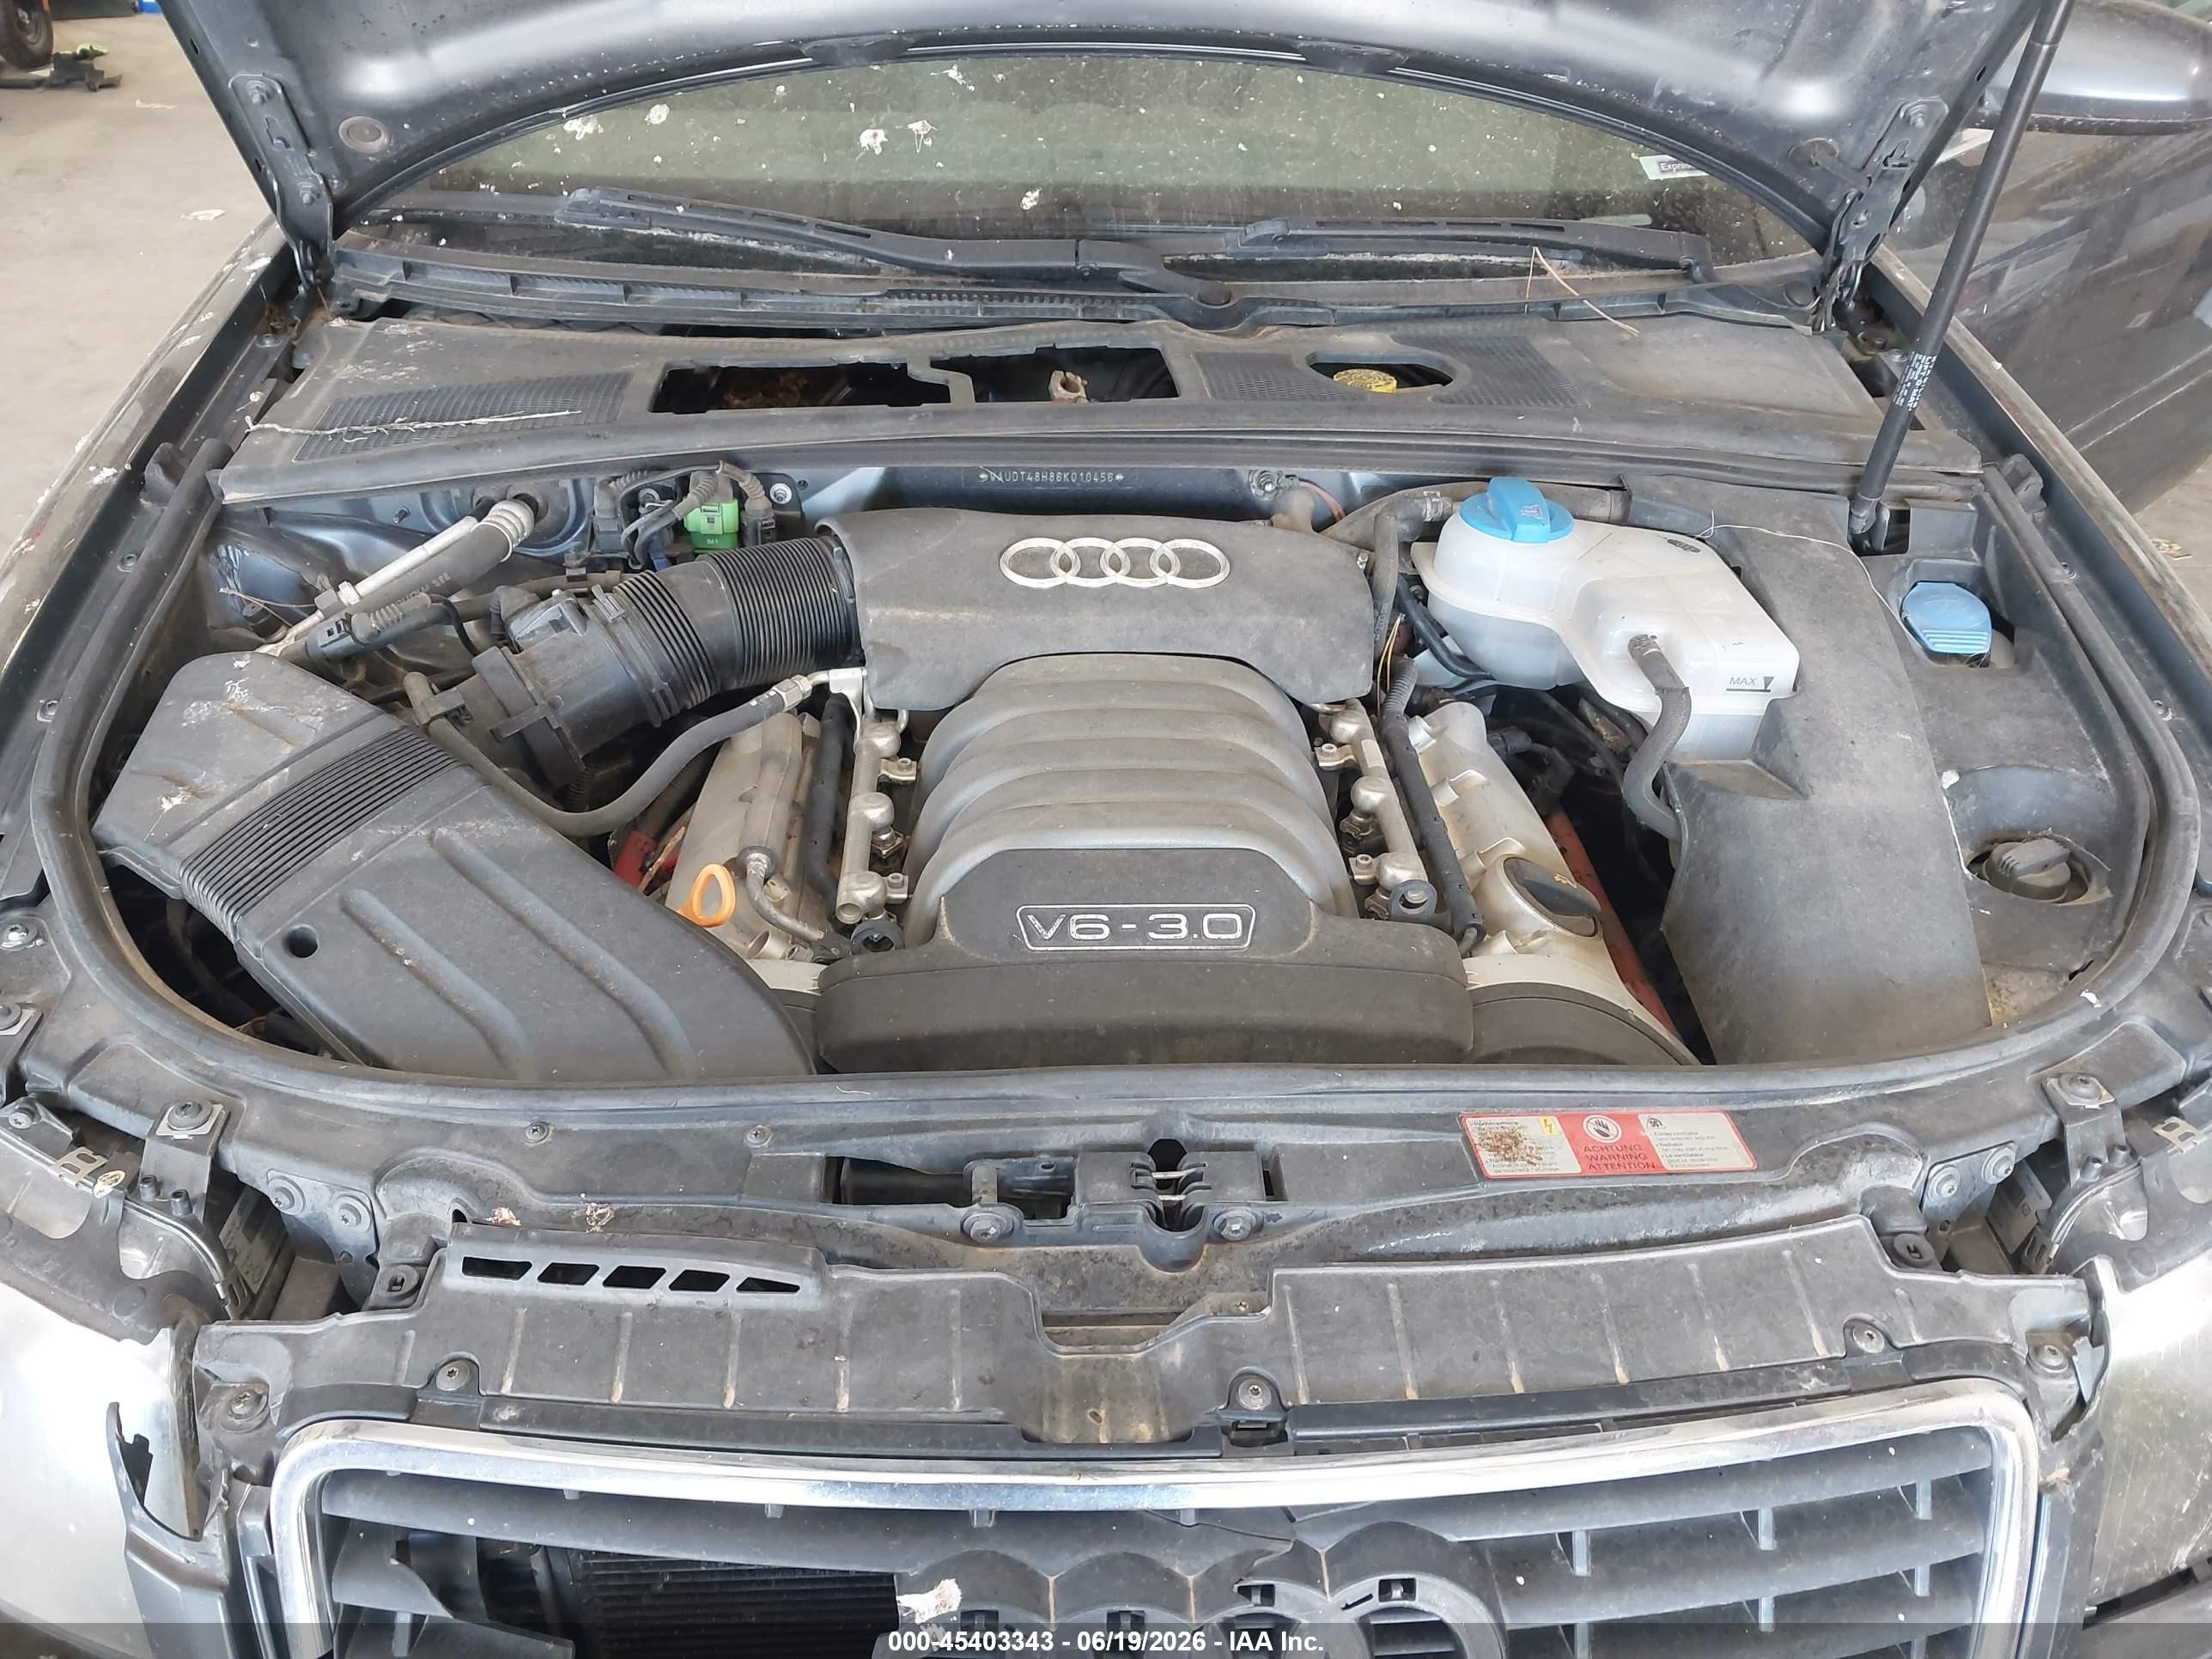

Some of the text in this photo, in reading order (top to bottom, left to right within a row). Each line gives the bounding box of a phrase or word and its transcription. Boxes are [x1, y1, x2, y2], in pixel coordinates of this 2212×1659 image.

[1729, 677, 1758, 686] MAX
[1583, 1143, 1643, 1153] ACHTUNG
[1586, 1152, 1649, 1162] WARNING
[1589, 1162, 1656, 1171] ATTENTION
